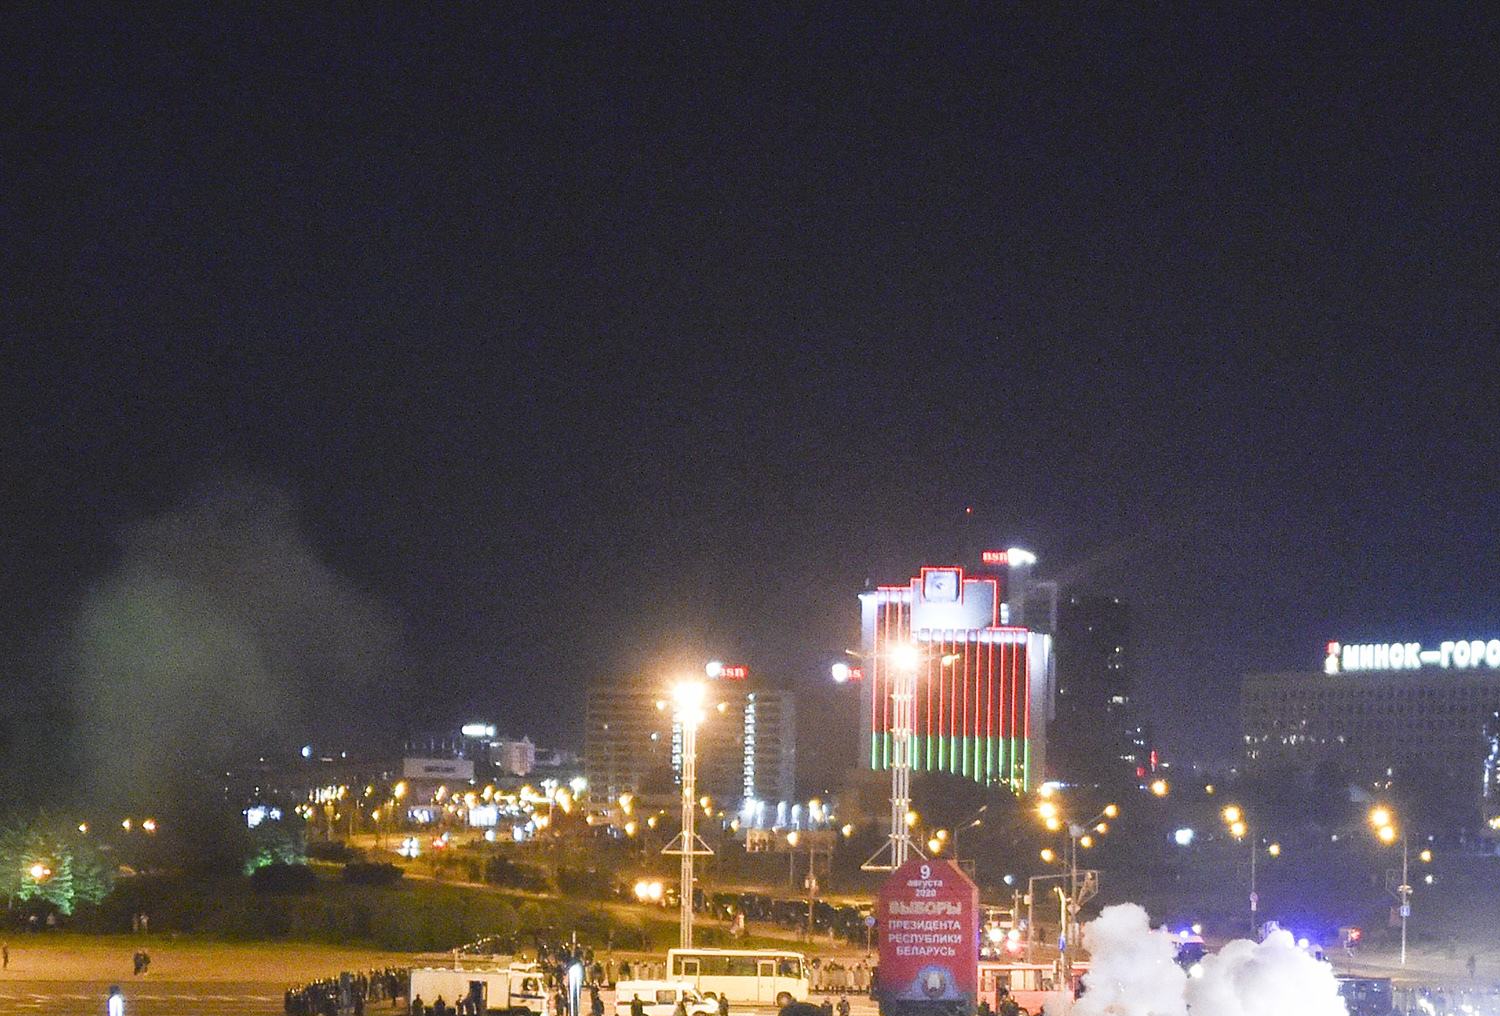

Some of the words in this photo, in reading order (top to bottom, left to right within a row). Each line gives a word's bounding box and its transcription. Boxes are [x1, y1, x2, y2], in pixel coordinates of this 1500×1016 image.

[920, 864, 931, 880] 9
[915, 888, 937, 898] 2020
[889, 901, 962, 915] ВЫБОРЫ
[888, 920, 961, 931] ПРЕЗИДЕНТА
[888, 933, 962, 944] РЕСПУБЛИКИ
[896, 946, 956, 956] БЕЛАРУСЬ
